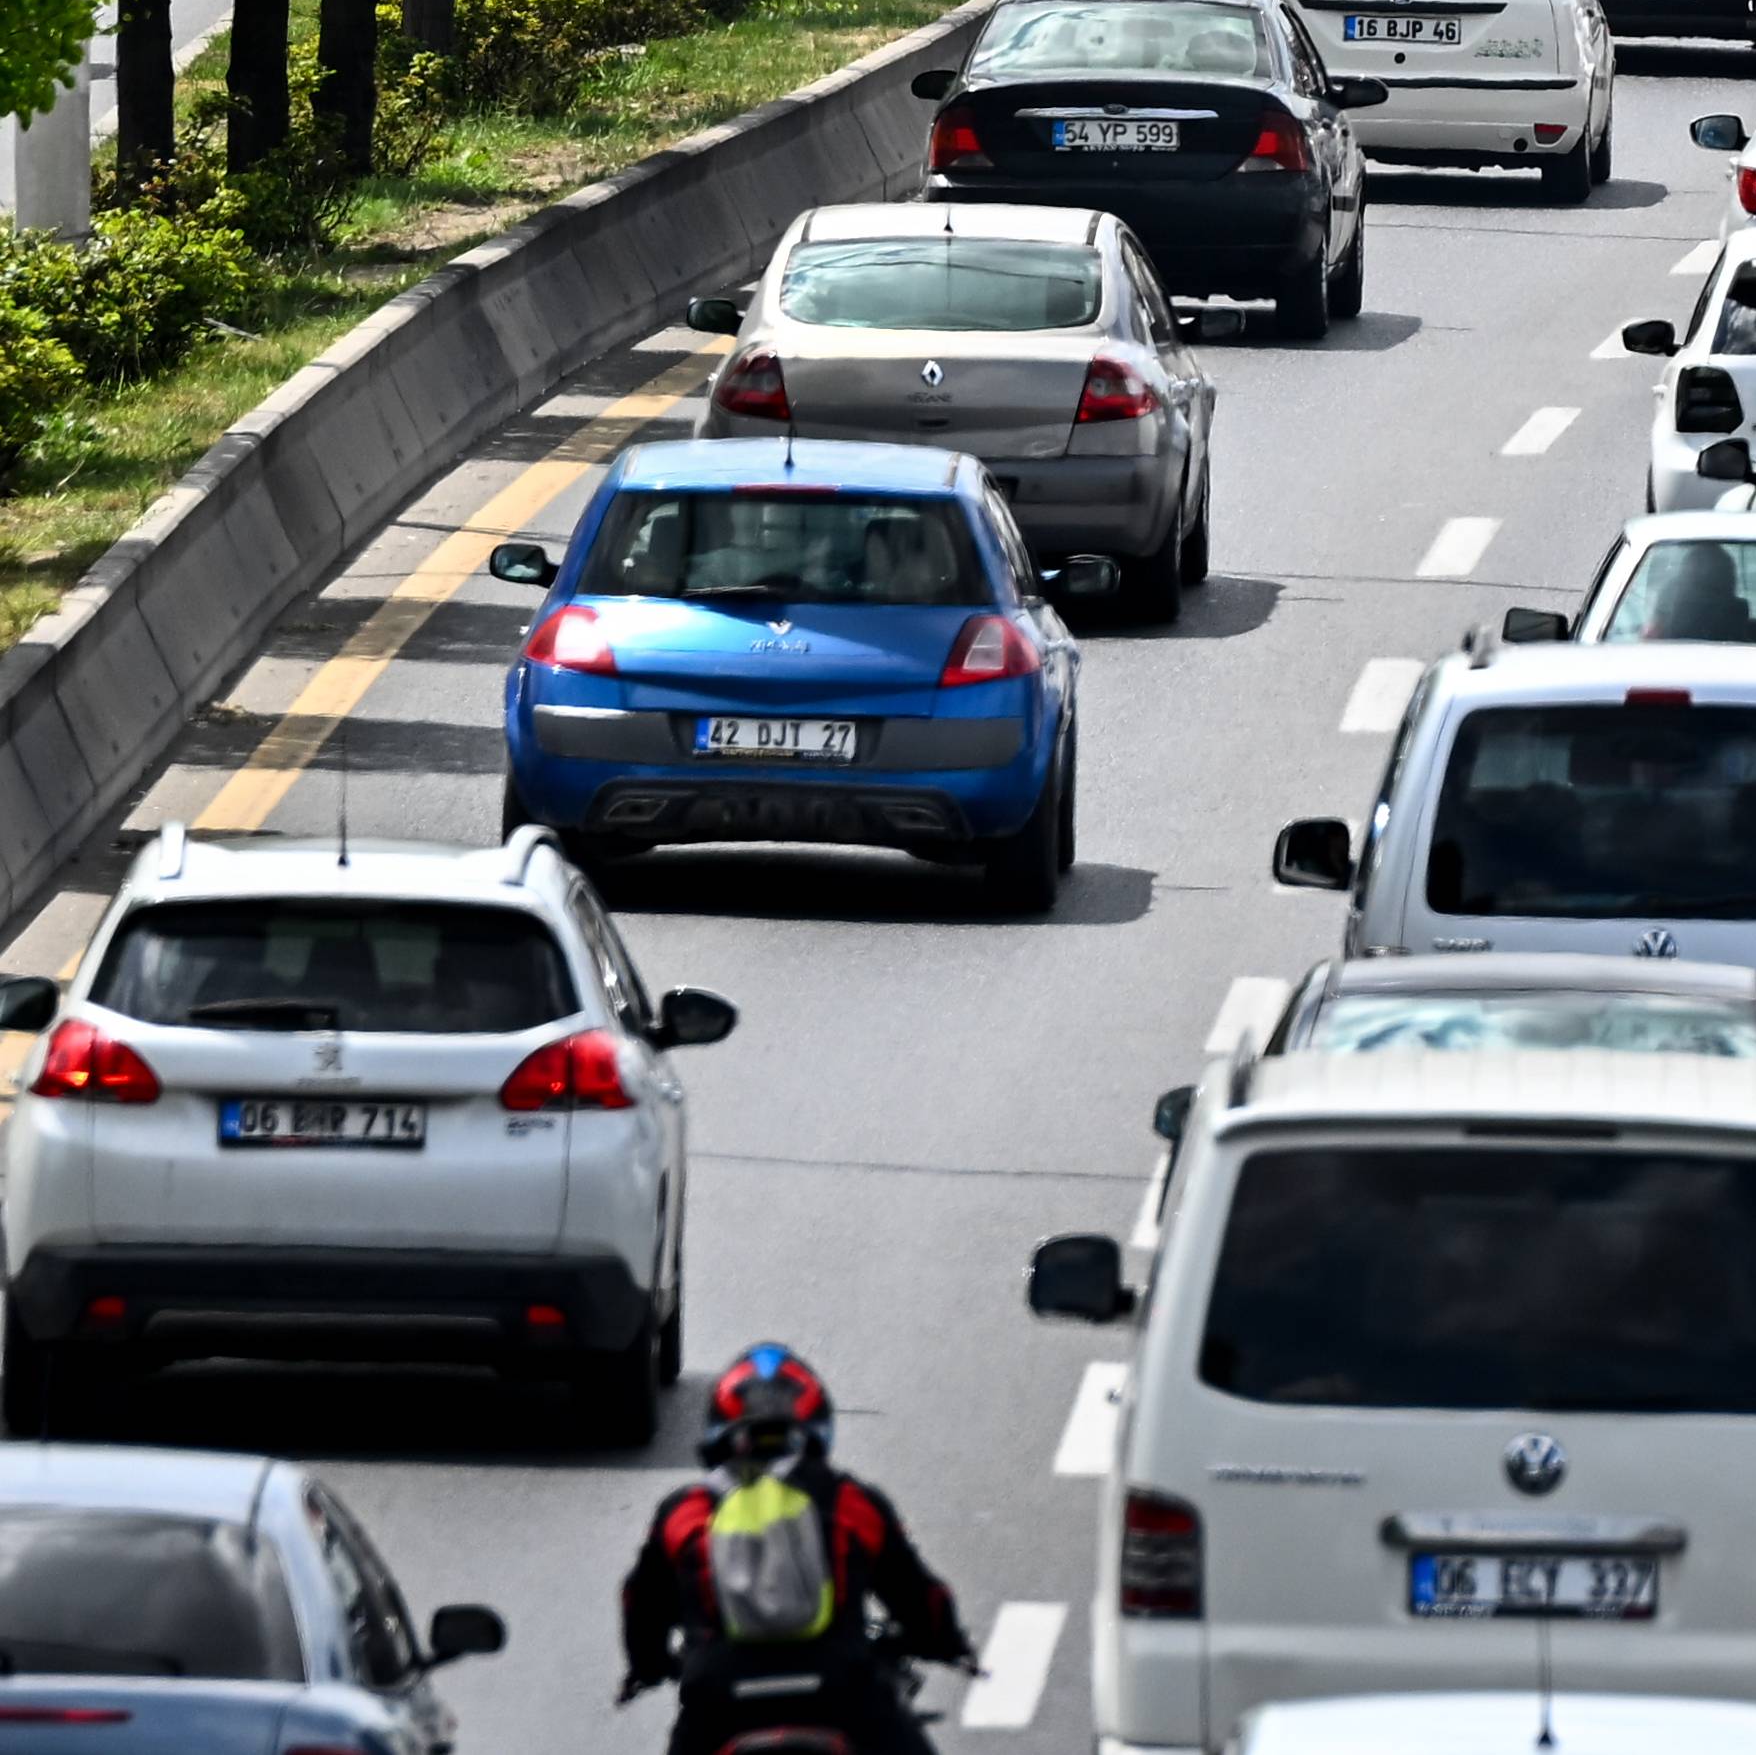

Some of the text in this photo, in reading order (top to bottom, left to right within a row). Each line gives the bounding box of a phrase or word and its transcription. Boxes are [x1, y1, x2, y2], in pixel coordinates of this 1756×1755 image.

[1357, 19, 1457, 41] 16 BJP 46
[1065, 122, 1175, 145] 54 YP 599
[710, 720, 853, 750] 42 DJT 27
[240, 1103, 280, 1133] 06
[362, 1103, 417, 1139] 714
[1433, 1557, 1478, 1598] 06
